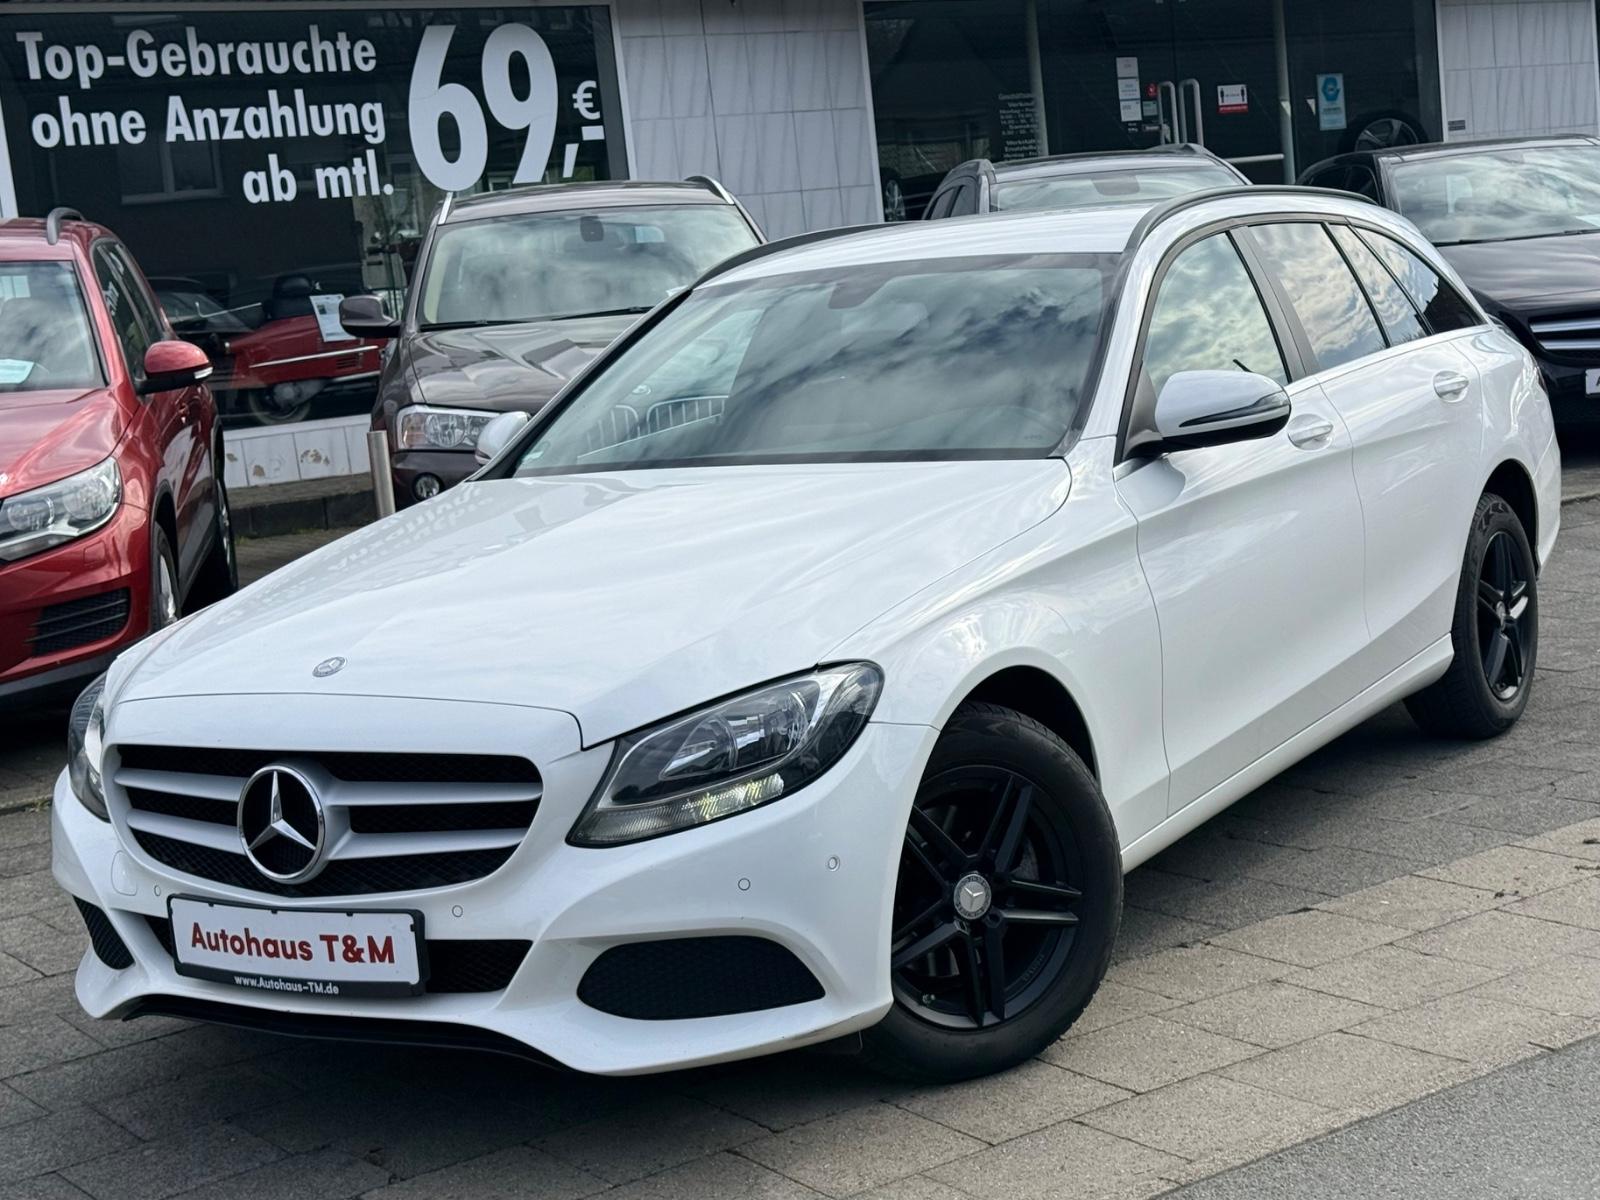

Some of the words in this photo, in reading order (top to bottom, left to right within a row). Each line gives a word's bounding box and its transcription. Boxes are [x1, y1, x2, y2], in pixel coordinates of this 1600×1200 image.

[16, 25, 377, 89] Top-Gebrauchte
[31, 96, 147, 149] ohne
[165, 89, 386, 143] Anzahlung
[243, 154, 297, 203] ab
[315, 149, 394, 200] mtl.
[191, 922, 313, 961] Autohaus
[319, 934, 395, 964] T&M
[234, 974, 340, 995] www.Autohaus-TM.de
